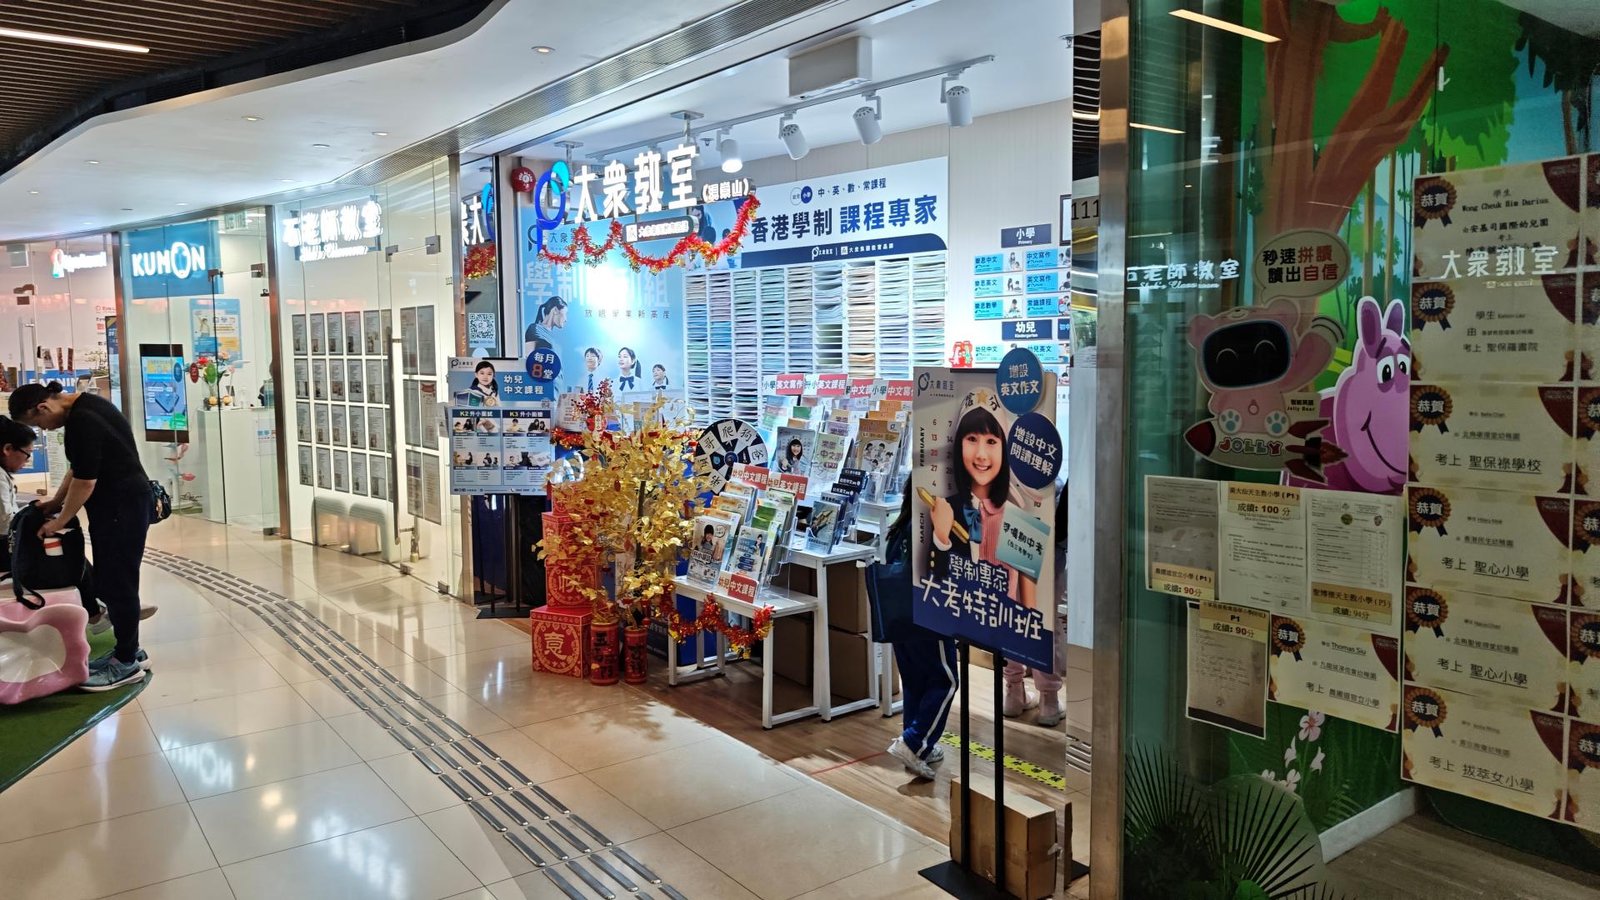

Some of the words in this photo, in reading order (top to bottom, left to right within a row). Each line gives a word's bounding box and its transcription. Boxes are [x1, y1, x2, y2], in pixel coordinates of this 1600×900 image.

[1421, 193, 1448, 208] 恭賀
[751, 208, 833, 243] 香港學制
[840, 195, 938, 234] 課程專家
[1016, 227, 1035, 240] 小學
[132, 241, 206, 279] KUMON
[1268, 264, 1339, 284] 讀出自信
[1419, 297, 1447, 310] 恭賀
[1015, 322, 1036, 333] 幼兒
[534, 352, 555, 364] 每月
[1009, 363, 1029, 378] 增設
[503, 375, 523, 384] 幼兒
[503, 385, 544, 395] 中文課程
[872, 386, 887, 396] 小學
[887, 385, 913, 397] 中文寫
[1001, 380, 1040, 397] 英文作文
[1417, 399, 1444, 413] 恭賀
[932, 418, 937, 426] 6
[740, 428, 752, 441] 狗
[931, 434, 938, 442] 13
[1014, 425, 1058, 460] 增設中文
[1218, 437, 1283, 455] JOLLY
[1010, 442, 1053, 477] 閱讀理解
[1435, 453, 1461, 467] 考上
[1261, 505, 1279, 514] 100
[1280, 507, 1291, 517] 分
[1416, 502, 1443, 516] 恭賀
[1441, 556, 1467, 571] 考上
[1474, 560, 1529, 579] 聖心小學
[920, 574, 1042, 641] 大考特訓班
[1413, 602, 1440, 616] 恭賀
[543, 632, 568, 661] 意
[1331, 641, 1355, 653] Thomas
[1437, 658, 1463, 673] 考上
[1470, 663, 1528, 685] 聖心小學
[1411, 701, 1438, 717] 恭賀
[1429, 755, 1455, 772] 考上
